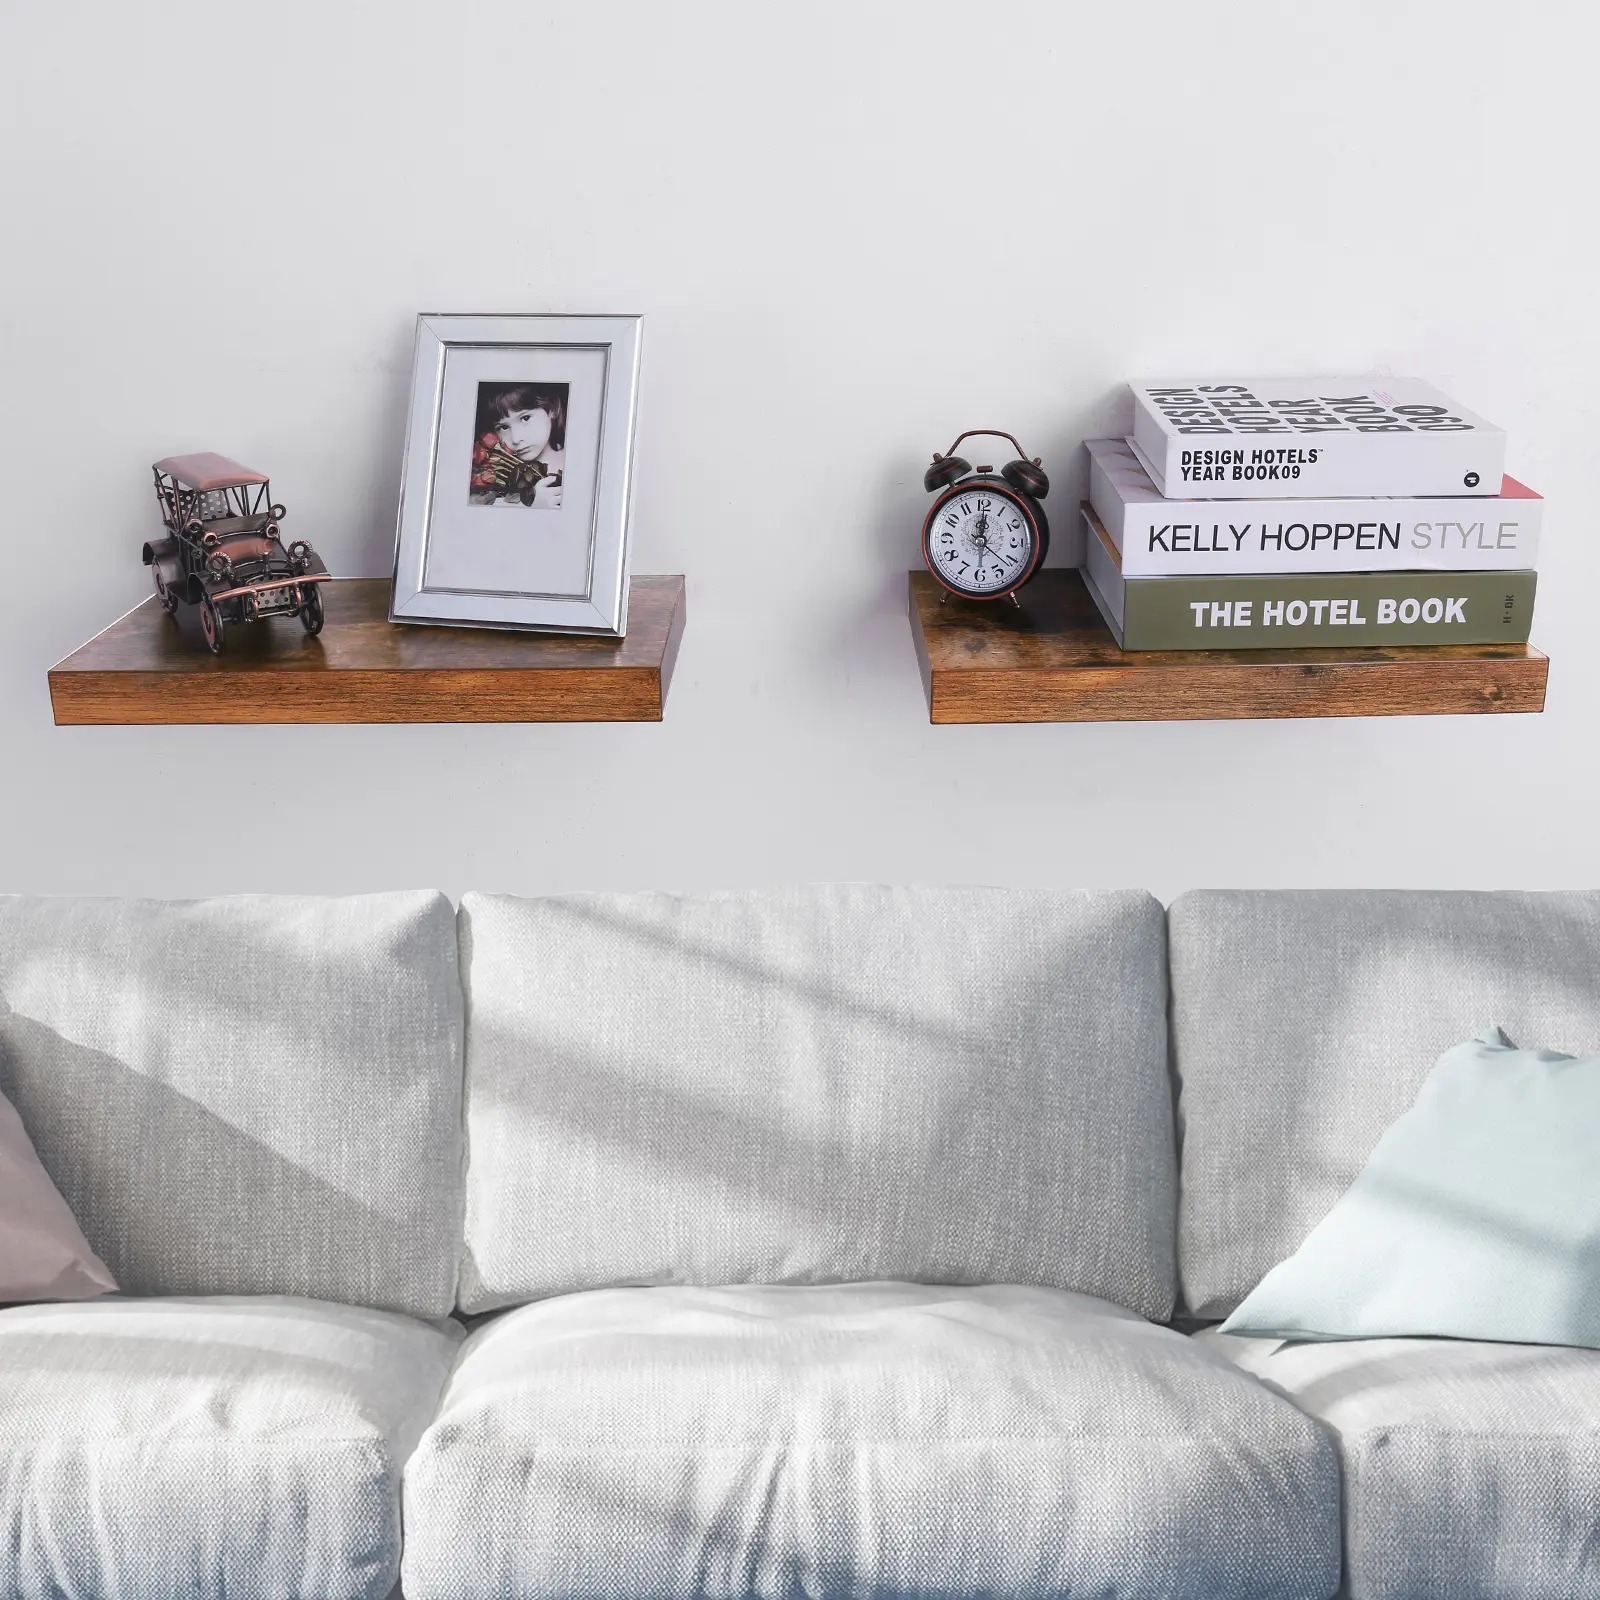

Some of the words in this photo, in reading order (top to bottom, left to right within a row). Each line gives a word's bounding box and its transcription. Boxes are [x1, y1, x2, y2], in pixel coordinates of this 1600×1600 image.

[1145, 388, 1233, 434] DESIGN
[1197, 385, 1293, 434] HOTELS
[1267, 398, 1351, 433] YEAR
[1318, 395, 1414, 432] BOOK
[1181, 450, 1244, 466] DESIGN
[1181, 466, 1225, 481] YEAR
[977, 499, 991, 511] 12
[945, 513, 960, 528] 10
[1006, 518, 1020, 532] 2
[940, 532, 954, 544] 9
[1148, 524, 1252, 552] KELLY
[1260, 523, 1401, 551] HOPPEN
[1411, 522, 1519, 550] STYLE
[944, 549, 959, 562] 8
[958, 560, 970, 575] 7
[974, 568, 986, 582] 6
[991, 564, 1004, 579] 5
[1190, 601, 1253, 628] THE
[1263, 599, 1367, 626] HOTEL
[1376, 597, 1469, 624] BOOK
